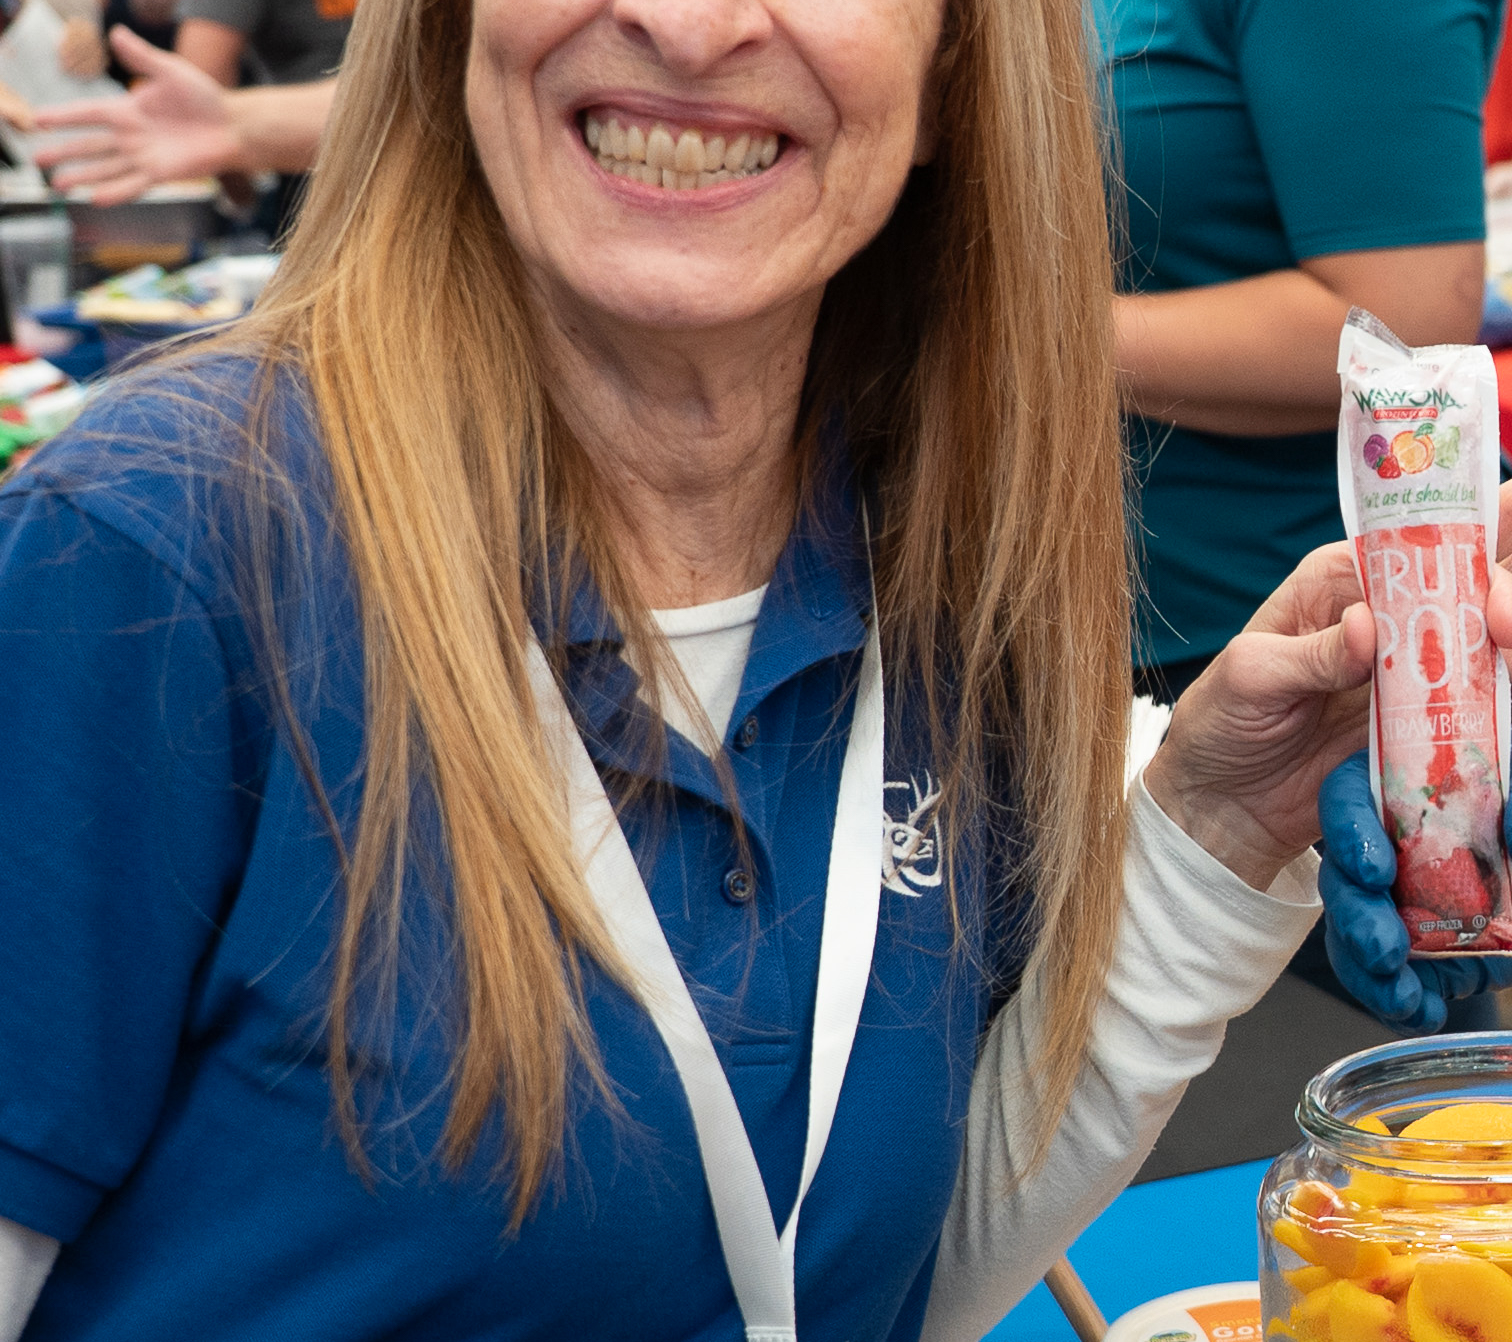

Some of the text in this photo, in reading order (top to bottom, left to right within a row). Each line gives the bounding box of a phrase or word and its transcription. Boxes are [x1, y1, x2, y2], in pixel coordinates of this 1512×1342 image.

[1352, 388, 1463, 414] WAWONA
[1382, 491, 1399, 507] as
[1401, 487, 1414, 503] it
[1415, 483, 1460, 503] should
[1367, 543, 1477, 603] FRUIT
